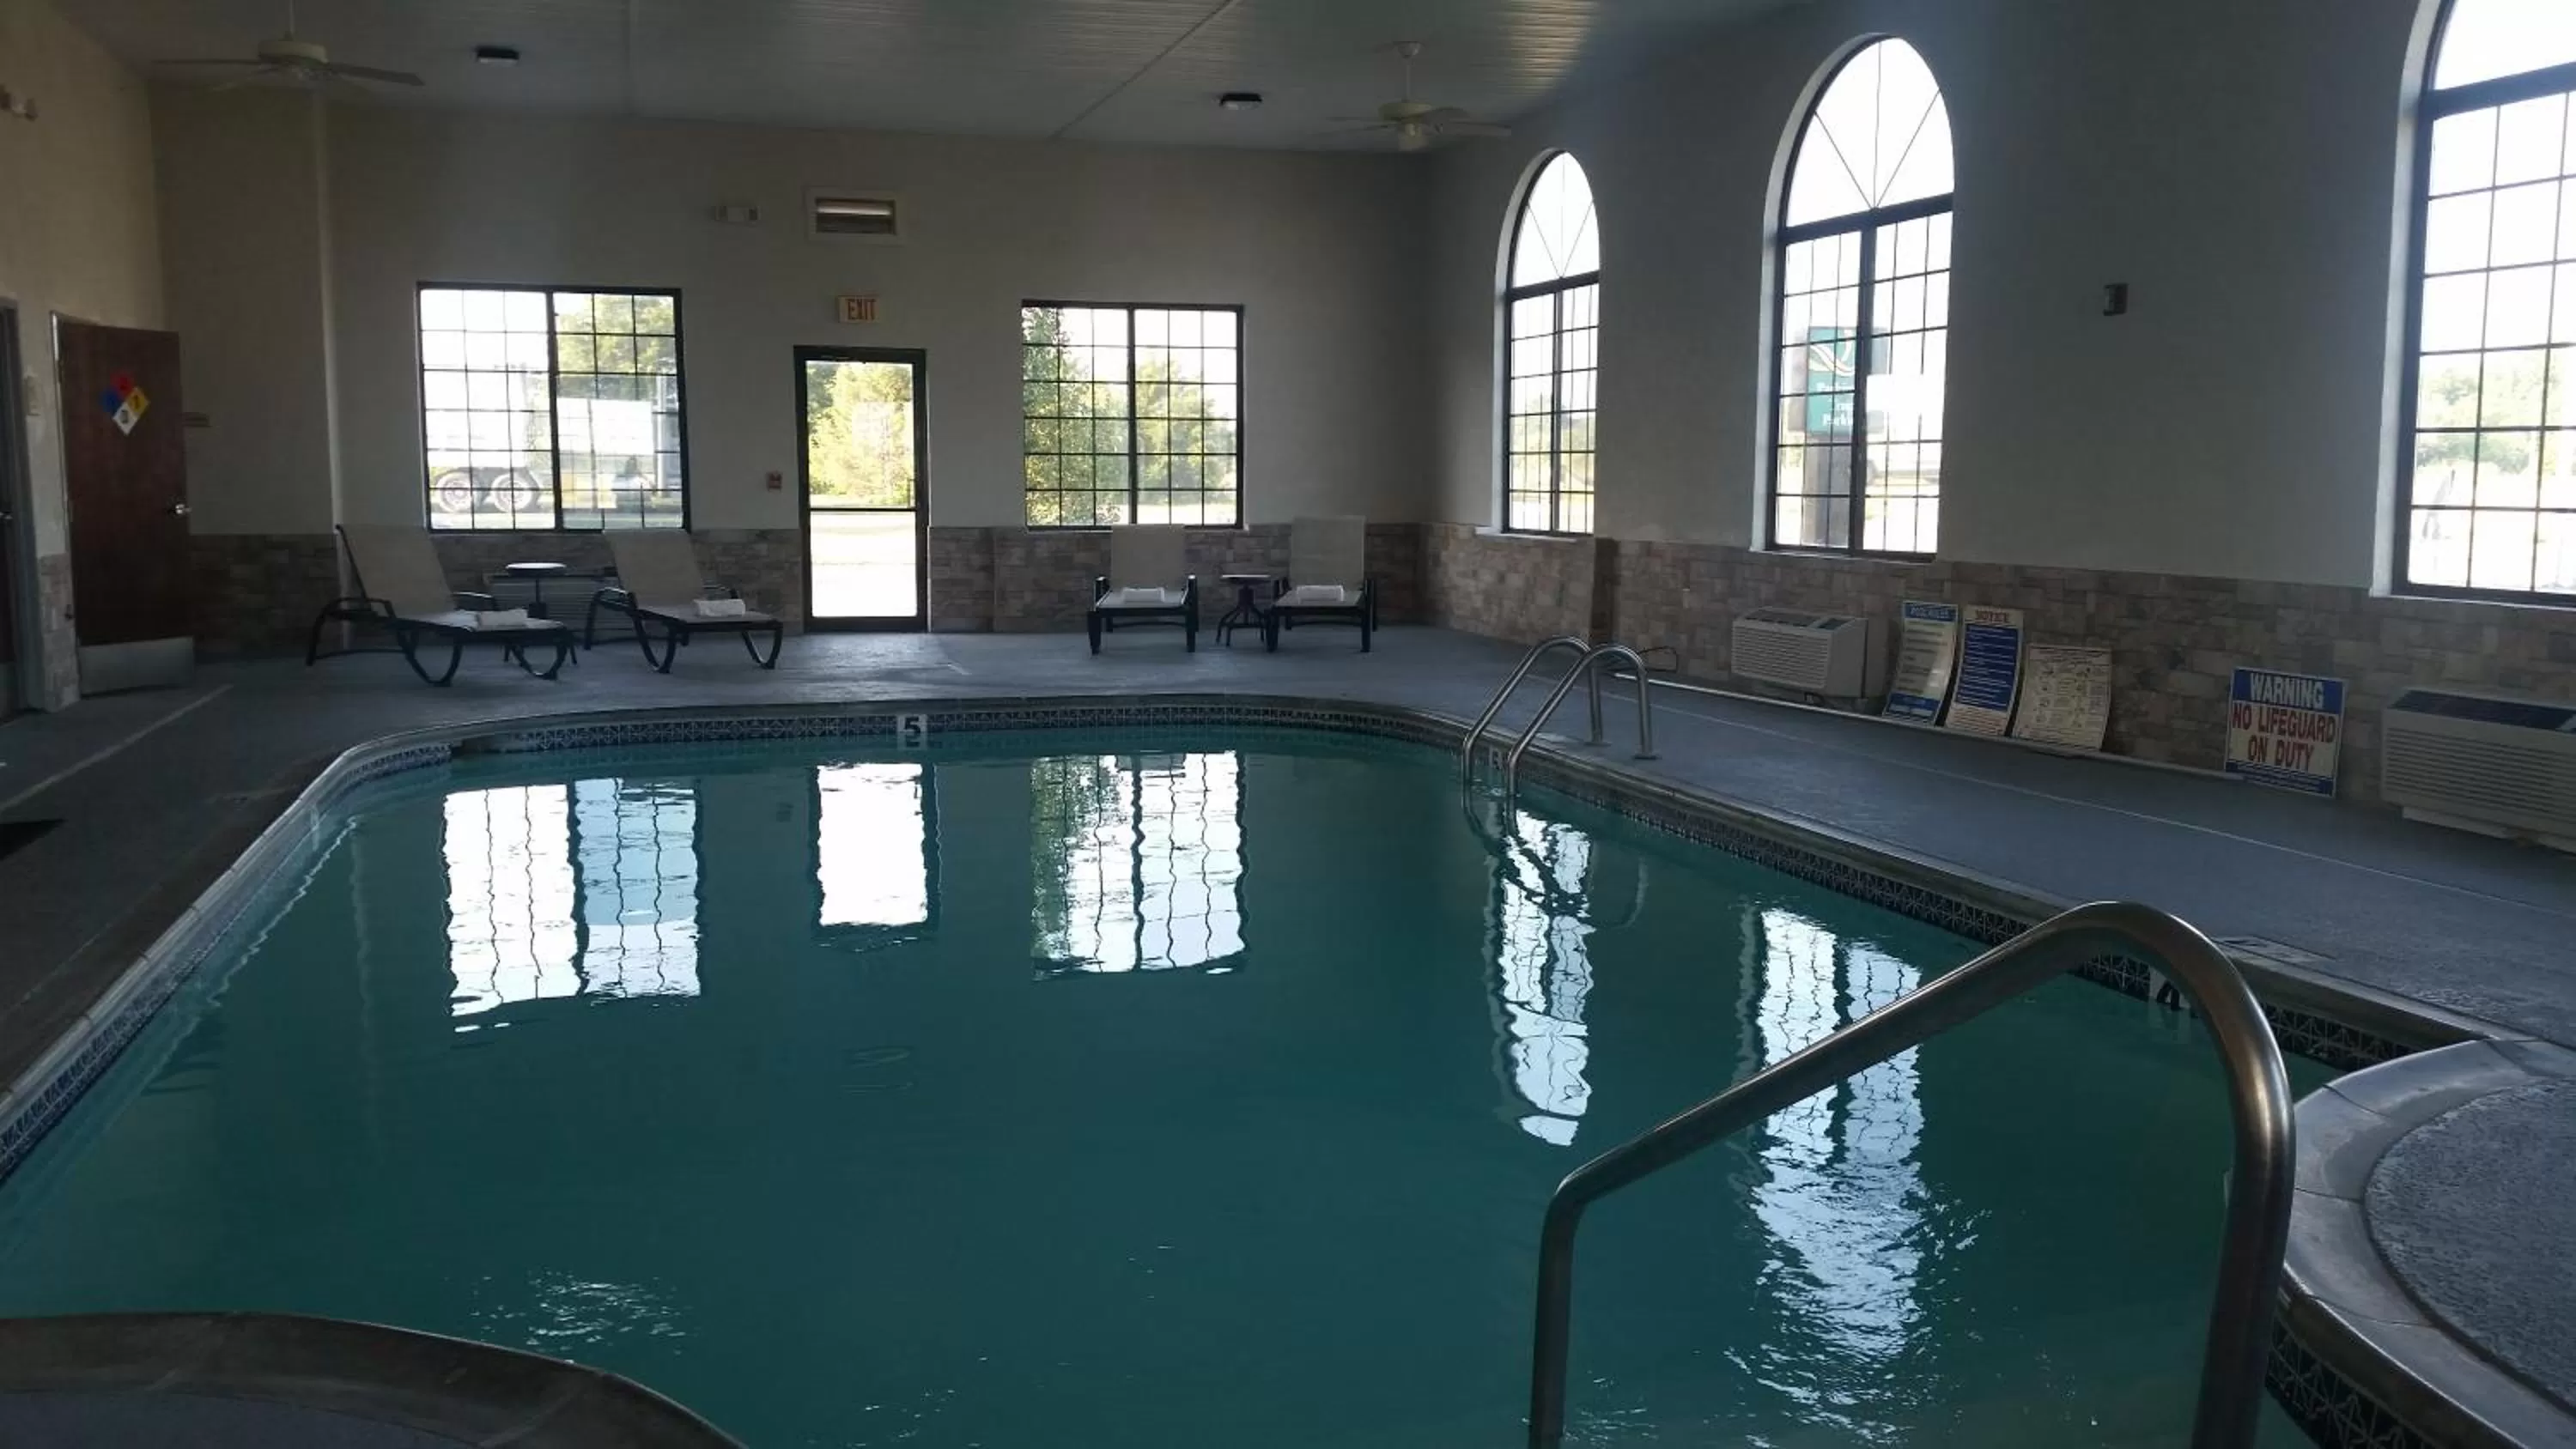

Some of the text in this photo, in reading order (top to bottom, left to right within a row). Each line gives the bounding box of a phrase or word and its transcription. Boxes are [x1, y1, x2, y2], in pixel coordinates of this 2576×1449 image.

[847, 298, 877, 320] EXIT
[2250, 672, 2325, 710] WARNING
[903, 716, 921, 737] 5
[2232, 701, 2336, 743] NO LIFEGUARD
[2247, 735, 2315, 773] ON DUTY
